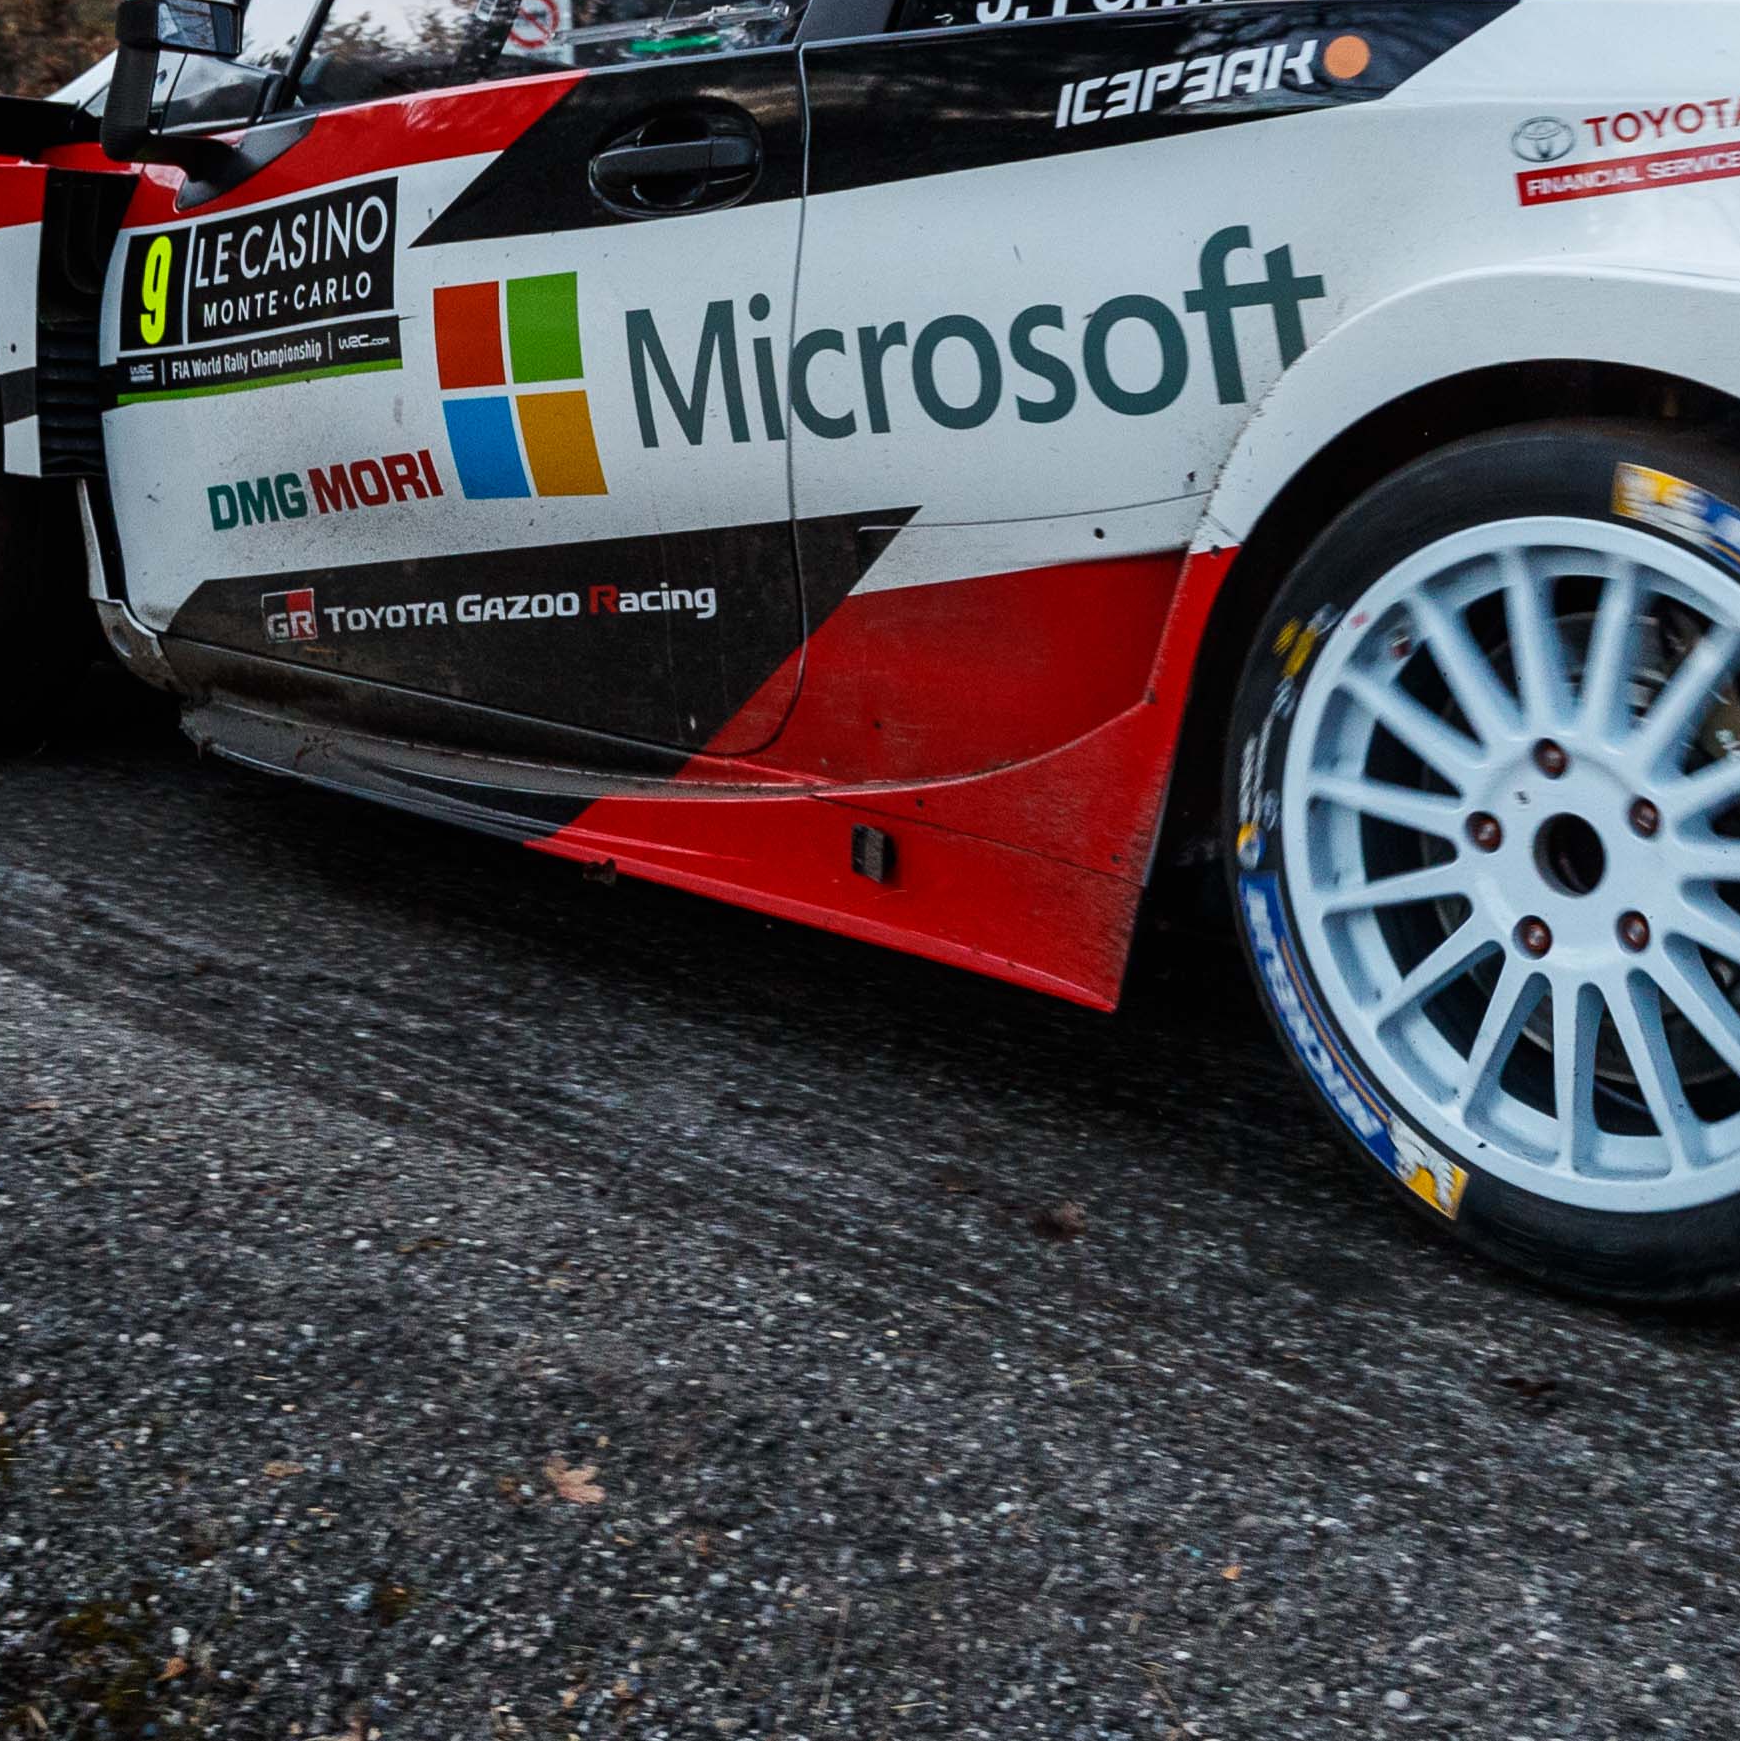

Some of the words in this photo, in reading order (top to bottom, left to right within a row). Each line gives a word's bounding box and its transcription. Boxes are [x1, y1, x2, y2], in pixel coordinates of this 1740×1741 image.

[1055, 39, 1319, 129] ICEPEAK
[1525, 165, 1645, 198] FINANCIAL
[194, 231, 233, 289] LE
[239, 195, 389, 281] CASINO
[139, 235, 173, 345] 9
[171, 361, 191, 381] FIA
[192, 356, 222, 379] World
[224, 352, 249, 375] Rally
[251, 340, 323, 369] Championship
[624, 224, 1327, 450] Microsoft
[207, 472, 308, 532] DMG
[308, 448, 445, 515] MORI
[266, 610, 317, 640] GR
[323, 600, 449, 634] TOYOTA
[455, 591, 580, 623] GAZOO
[588, 582, 717, 620] Racing
